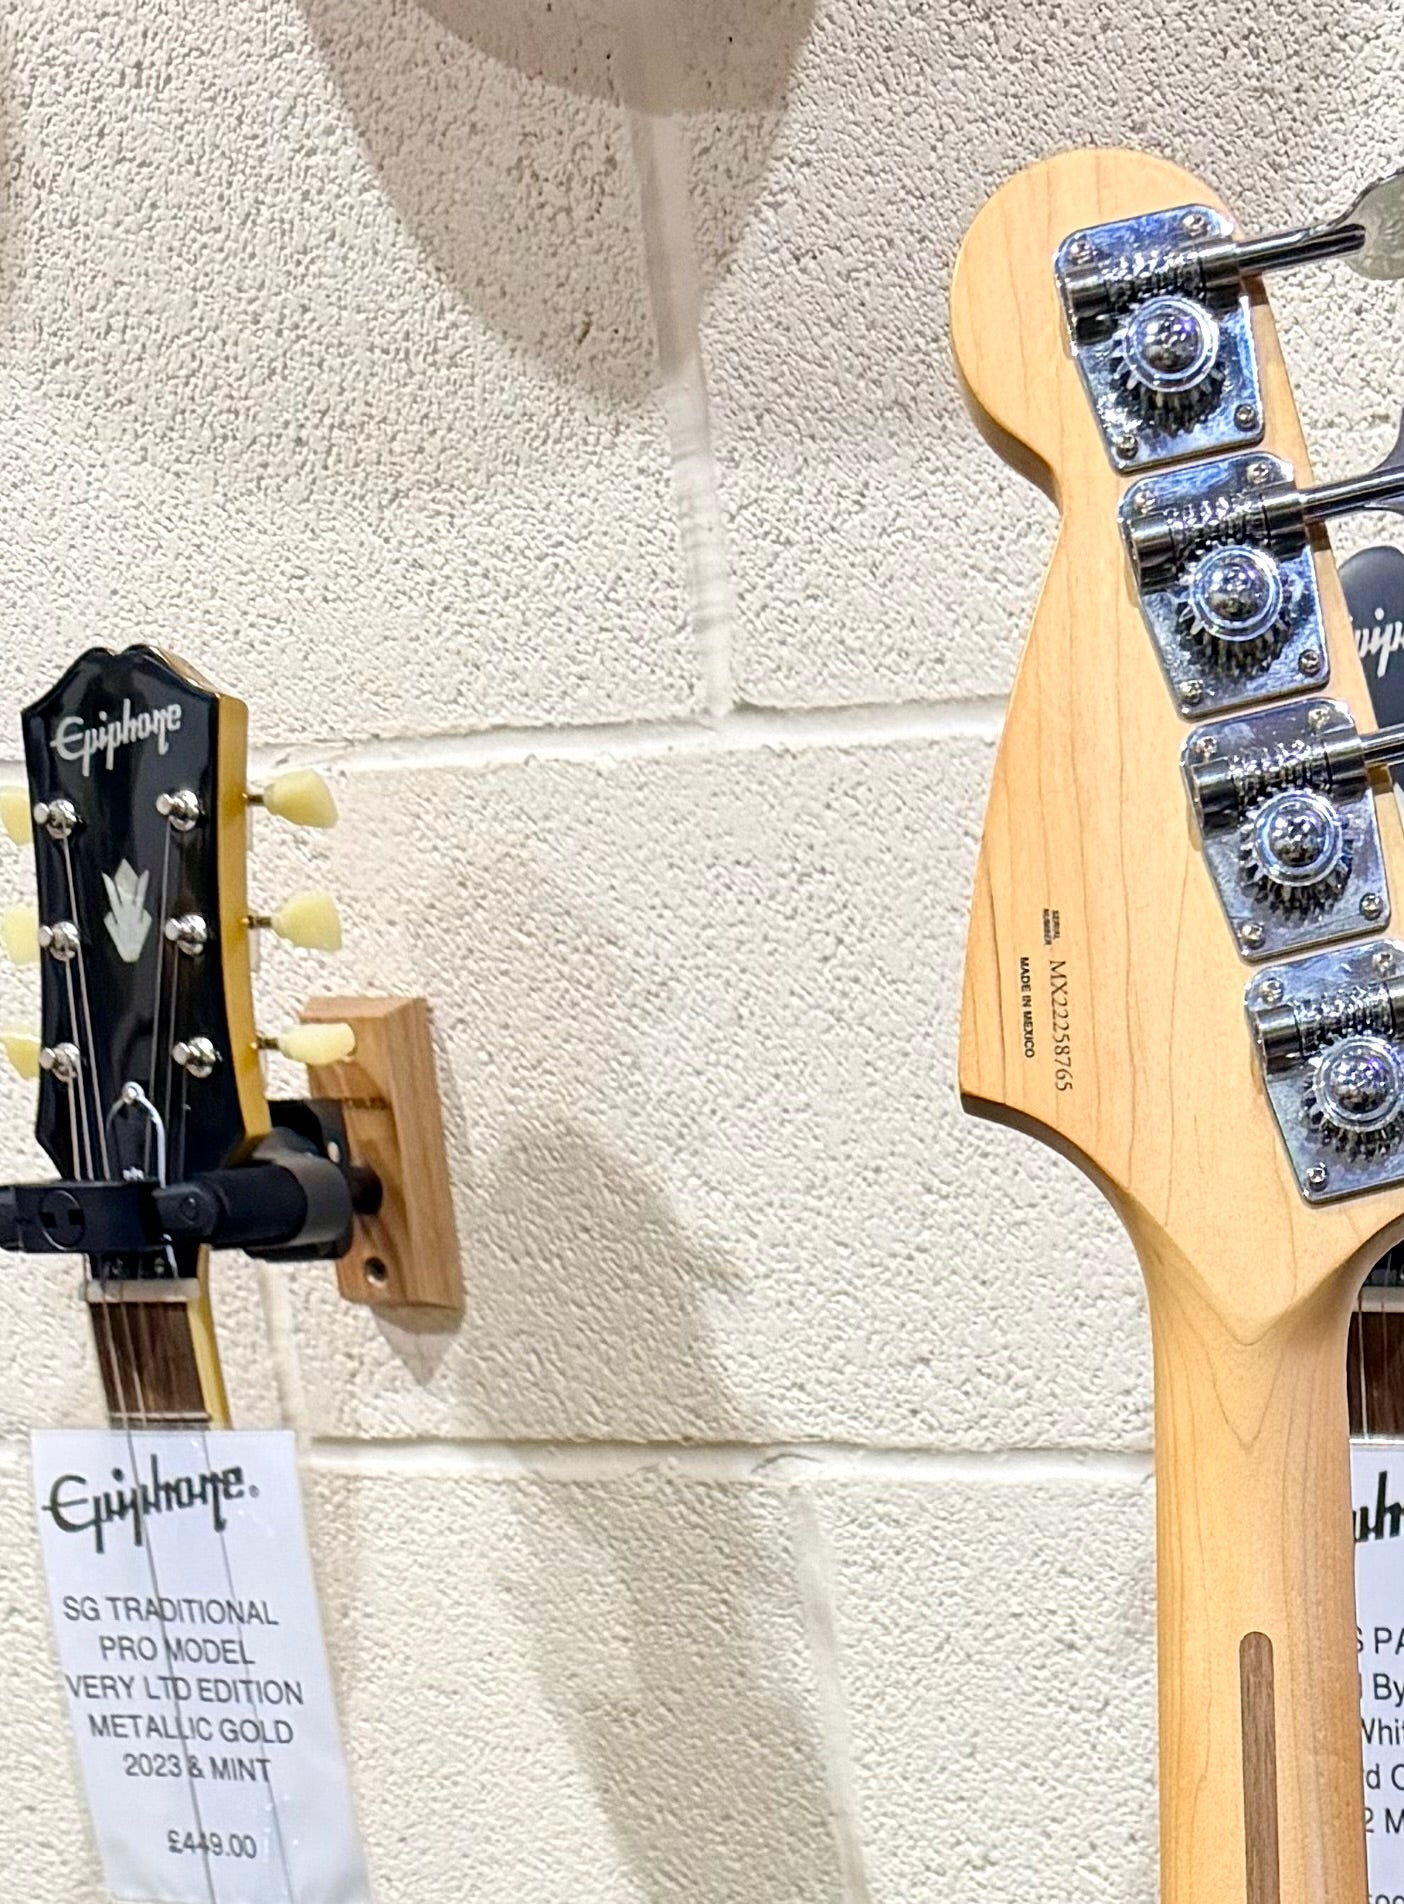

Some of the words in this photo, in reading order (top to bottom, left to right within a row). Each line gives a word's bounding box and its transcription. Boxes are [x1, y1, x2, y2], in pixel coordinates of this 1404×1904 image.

[50, 698, 182, 776] Epiphone
[1020, 957, 1031, 992] MADE
[1021, 995, 1031, 1008] IN
[1023, 1011, 1035, 1058] MEXICO
[1049, 960, 1073, 1092] MX22258765
[63, 1596, 100, 1622] SG
[106, 1597, 280, 1625] TRADITIONAL
[100, 1636, 156, 1661] PRO
[166, 1638, 255, 1665] MODEL
[65, 1675, 135, 1700] VERY
[144, 1678, 191, 1702] LTD
[201, 1679, 305, 1705] EDITION
[88, 1714, 213, 1742] METALLIC
[220, 1718, 294, 1744] GOLD
[124, 1753, 182, 1779] 2023
[189, 1756, 204, 1779] &
[211, 1756, 273, 1782] MINT
